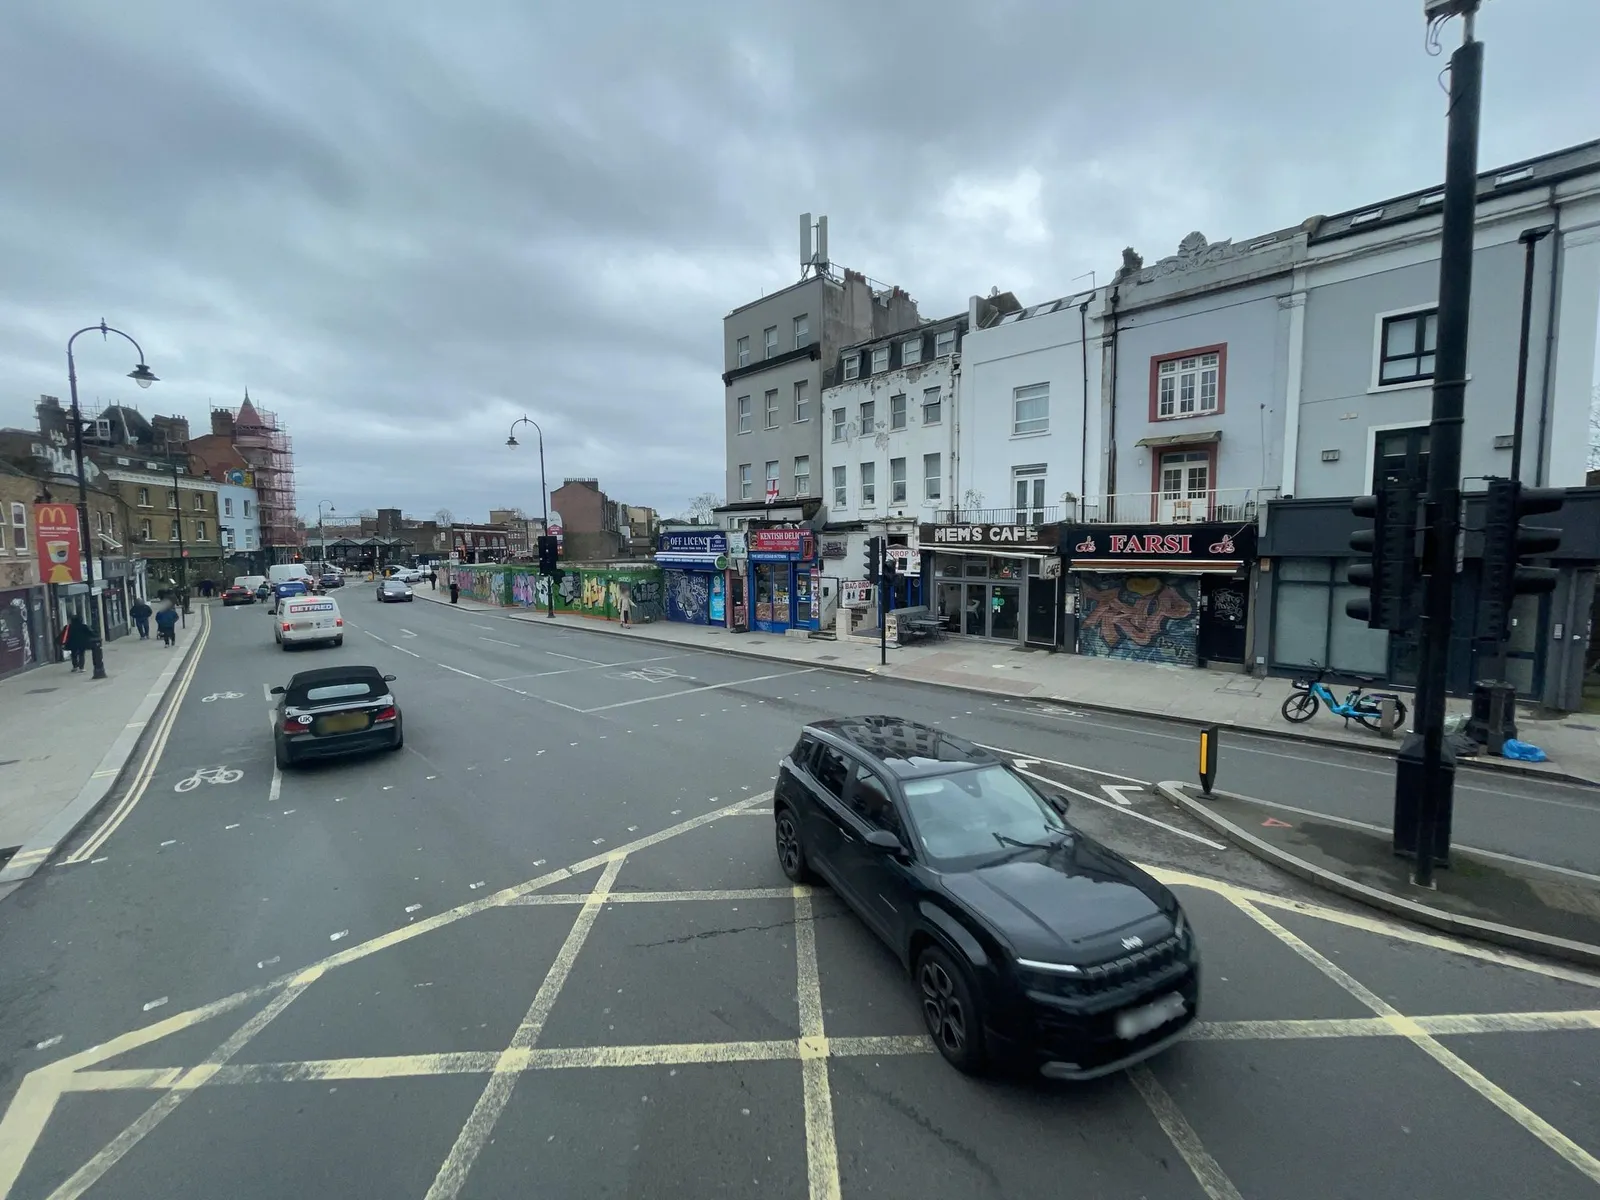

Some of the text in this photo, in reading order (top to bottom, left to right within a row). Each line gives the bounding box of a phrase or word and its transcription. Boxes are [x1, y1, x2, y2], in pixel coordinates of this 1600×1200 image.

[934, 526, 1039, 542] MEM'S CAFE
[670, 537, 708, 546] OFF LICENC
[1109, 534, 1193, 554] FARSI
[1046, 563, 1060, 576] CAFE
[291, 604, 332, 612] BETFRED
